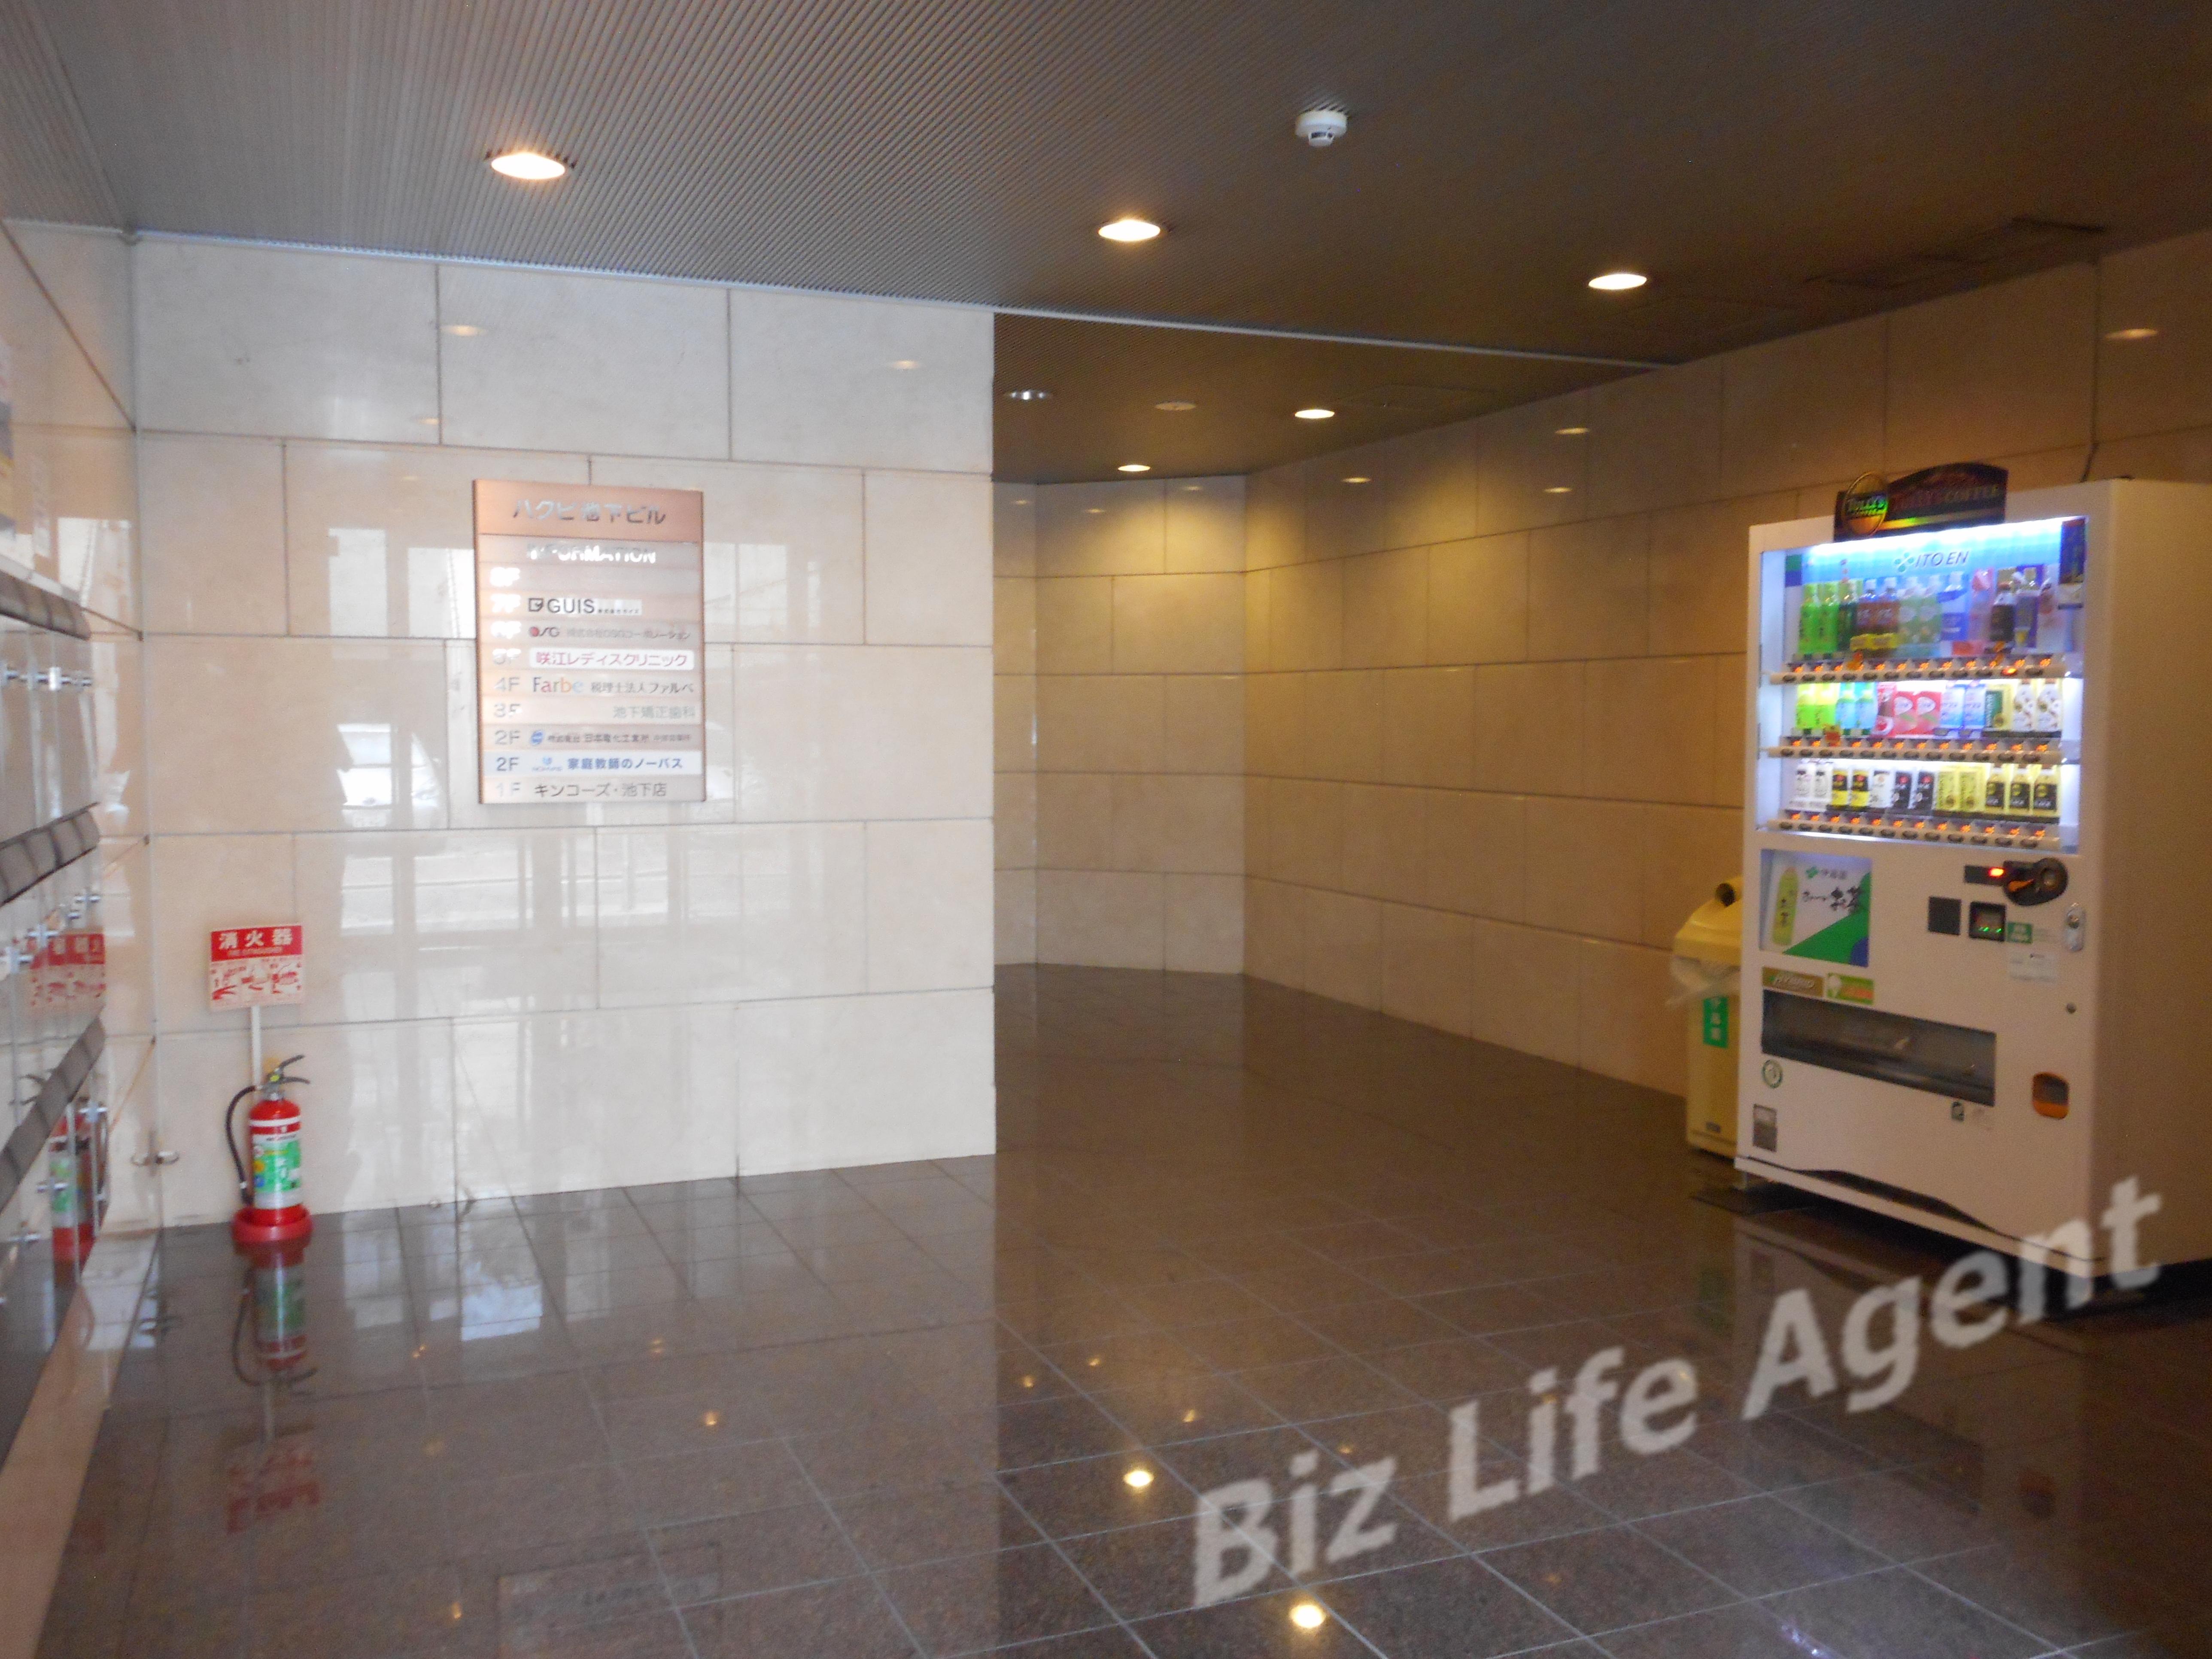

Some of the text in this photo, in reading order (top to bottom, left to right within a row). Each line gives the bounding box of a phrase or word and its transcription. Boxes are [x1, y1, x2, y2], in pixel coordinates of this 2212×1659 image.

[1914, 550, 1970, 568] ITO EN
[547, 599, 595, 614] GUIS
[536, 651, 688, 667] 咲江レディスクリニック
[494, 676, 520, 693] 4F
[532, 676, 584, 693] Farbe
[494, 703, 521, 718] 3F
[495, 729, 521, 745] 2F
[496, 757, 683, 771] 2F 家庭教師のノーバス
[218, 927, 293, 950] 消火器
